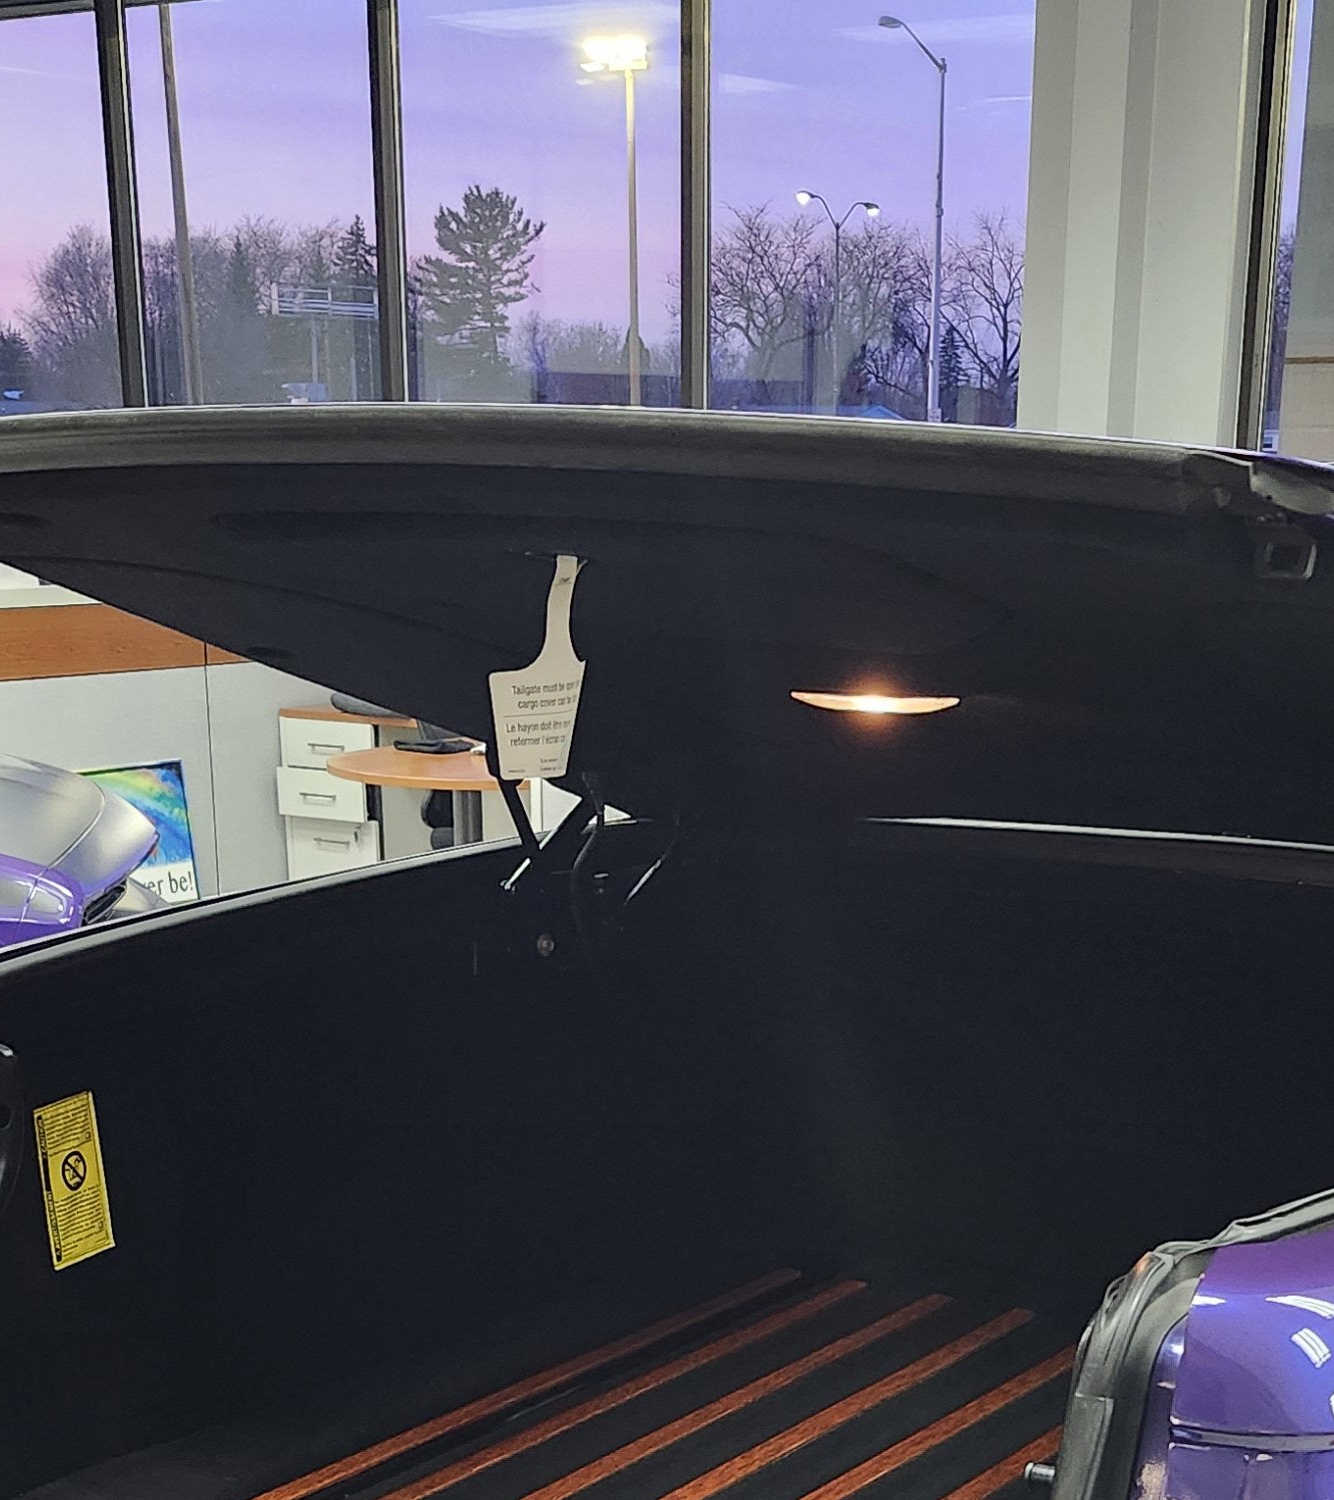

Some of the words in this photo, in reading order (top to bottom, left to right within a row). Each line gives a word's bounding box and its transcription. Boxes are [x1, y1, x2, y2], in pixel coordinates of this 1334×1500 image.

[511, 684, 541, 697] Tailgate
[517, 699, 538, 710] cargo
[506, 723, 516, 733] Le
[167, 870, 194, 894] be!
